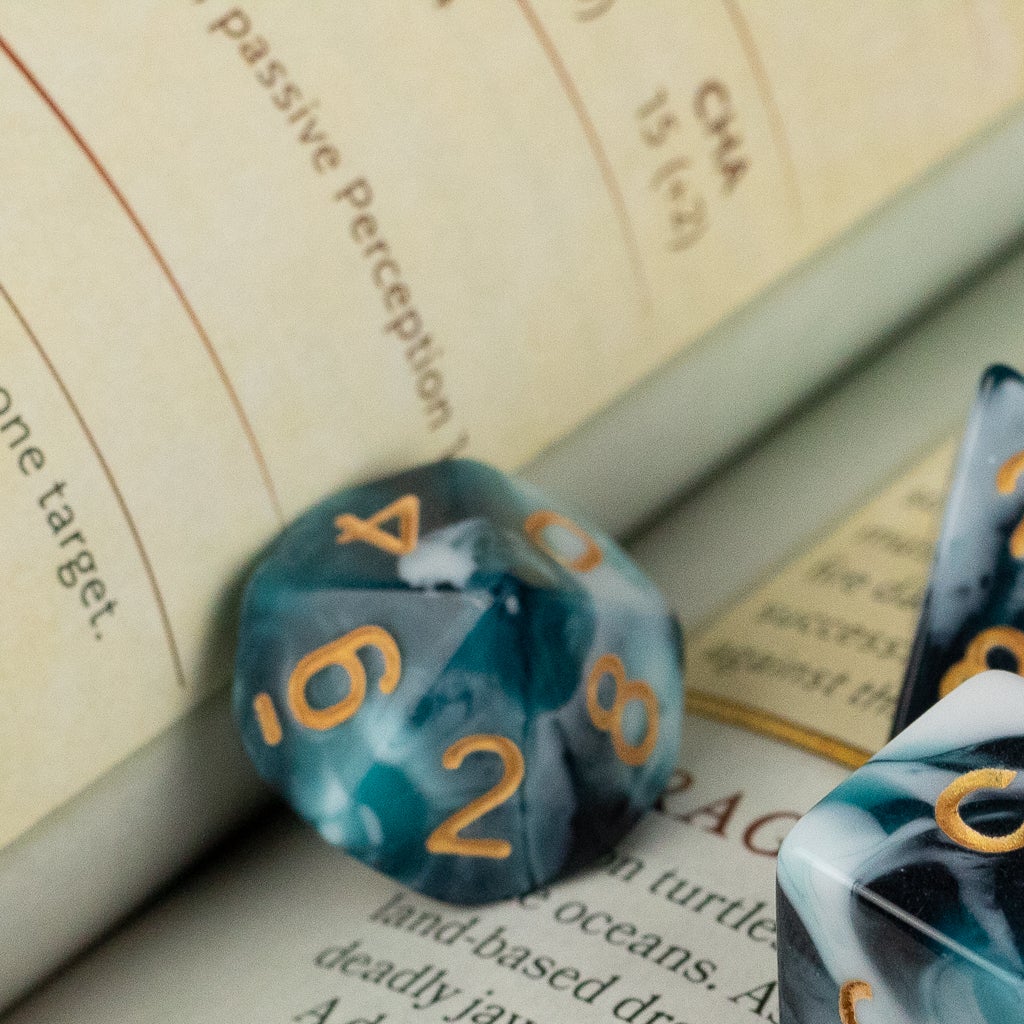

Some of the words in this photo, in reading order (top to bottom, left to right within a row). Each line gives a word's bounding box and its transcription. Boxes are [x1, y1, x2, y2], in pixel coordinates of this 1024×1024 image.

[693, 78, 750, 197] CHA
[208, 7, 341, 174] passive
[334, 177, 454, 431] Perception
[38, 480, 118, 642] target.
[334, 493, 421, 556] 4
[526, 511, 603, 573] 0
[587, 654, 660, 766] 8
[426, 734, 526, 860] 2
[369, 892, 618, 1006] land-based
[553, 899, 717, 991] oceans.
[648, 866, 779, 951] turtle
[313, 940, 461, 1010] deadly
